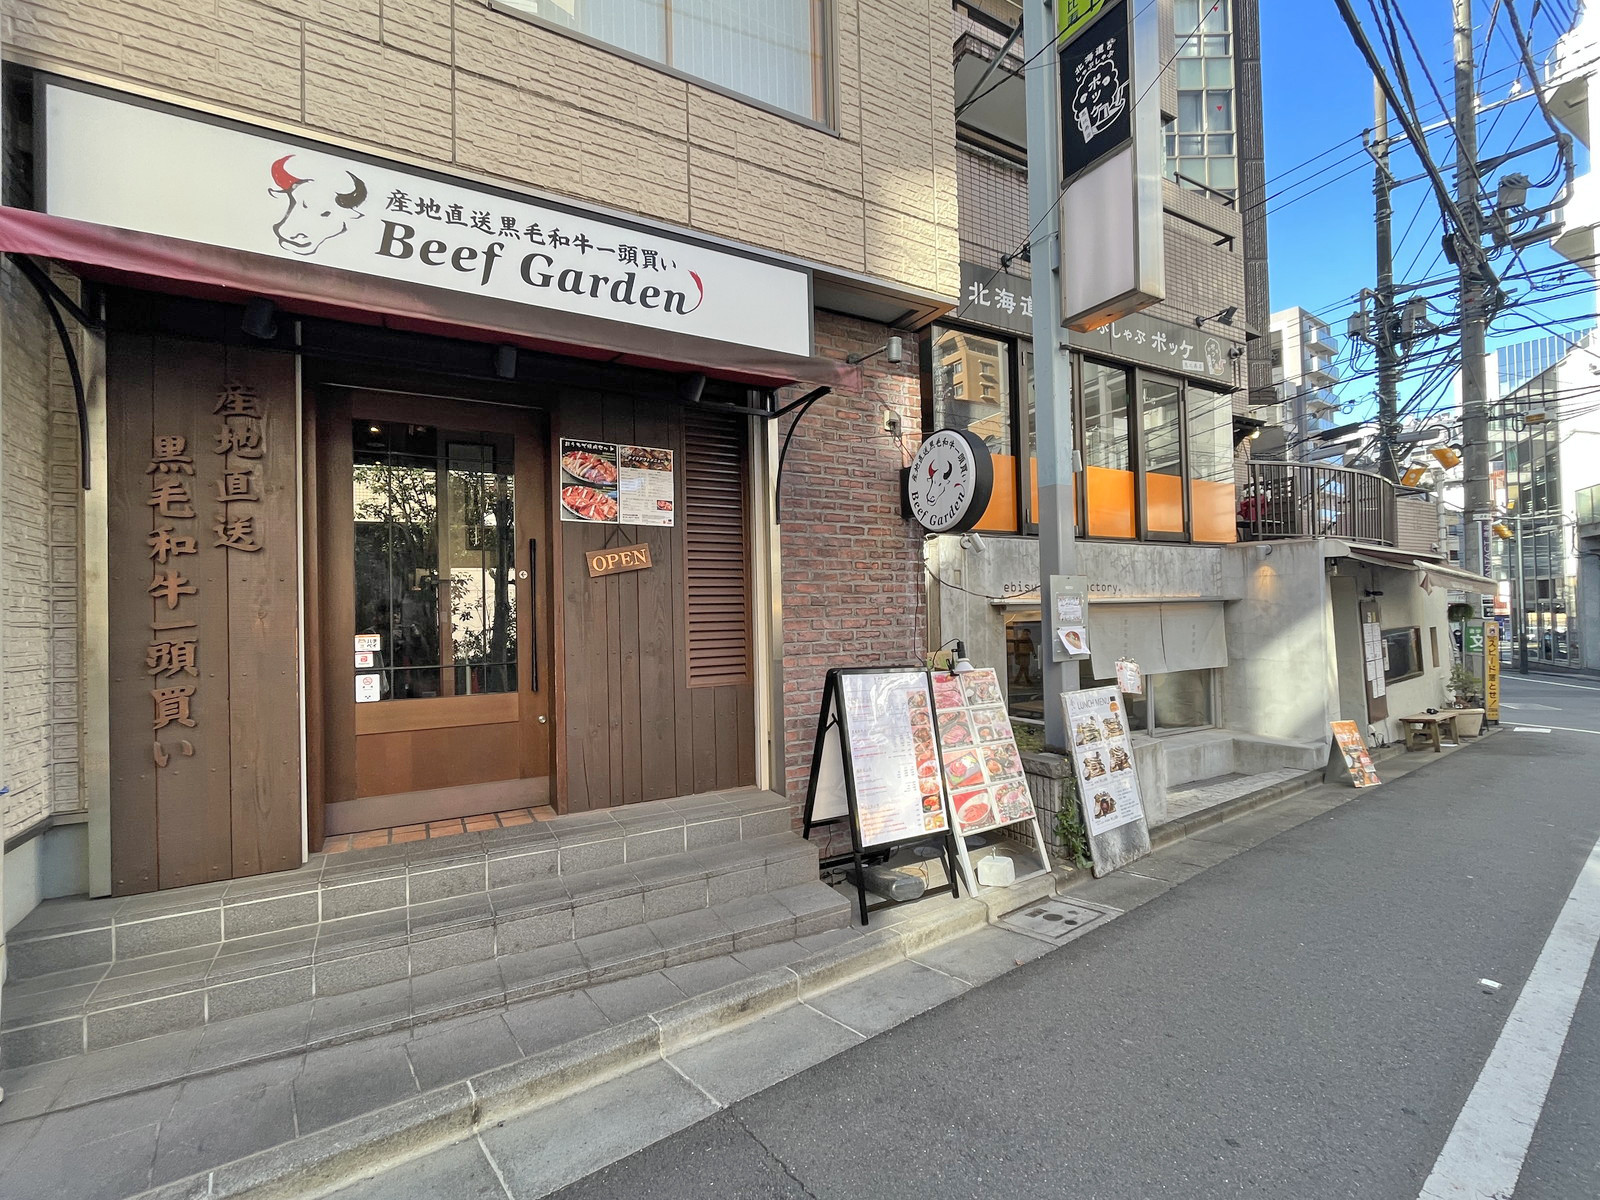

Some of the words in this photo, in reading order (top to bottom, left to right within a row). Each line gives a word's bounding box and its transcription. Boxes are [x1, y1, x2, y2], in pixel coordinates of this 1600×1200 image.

[1088, 72, 1103, 118] ポッケ
[385, 189, 677, 272] 産地直送黒毛和牛一頭買い
[374, 219, 505, 287] Beef
[520, 252, 703, 316] Garden
[1151, 331, 1194, 359] ポッケ
[212, 384, 263, 552] 産地直送
[911, 490, 928, 522] Beef
[929, 485, 966, 527] Garden
[592, 549, 648, 572] OPEN
[146, 435, 199, 768] 黒毛和牛一頭買い
[1004, 580, 1038, 593] ebisu
[1077, 699, 1095, 710] LUNCH
[1095, 696, 1110, 707] MENU
